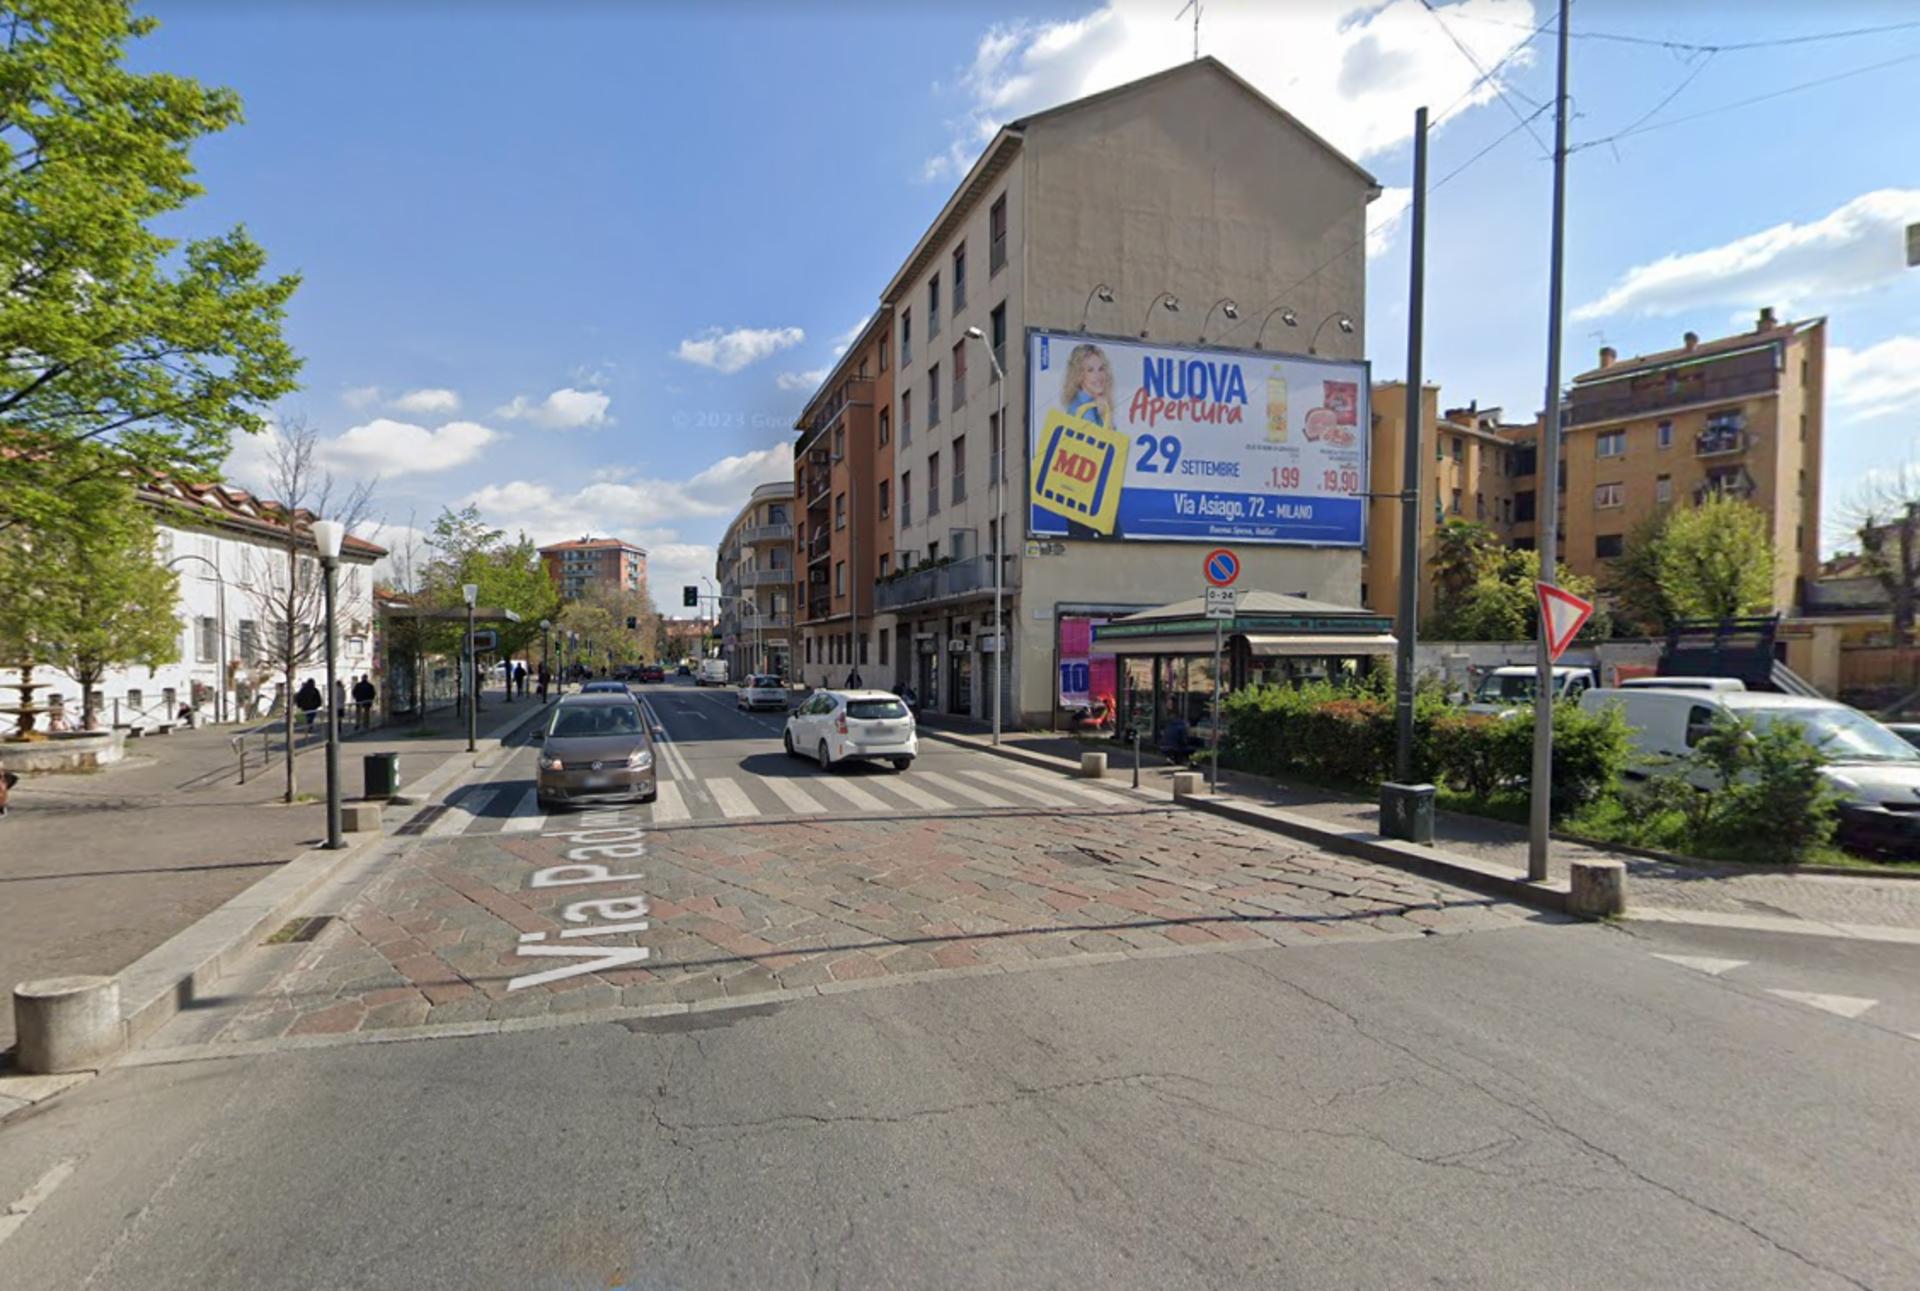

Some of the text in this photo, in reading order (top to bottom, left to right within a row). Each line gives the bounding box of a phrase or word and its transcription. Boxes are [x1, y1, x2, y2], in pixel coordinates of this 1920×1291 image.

[1143, 356, 1248, 405] NUOVA
[1128, 387, 1243, 428] Apertura
[1052, 448, 1098, 483] MD
[1136, 433, 1240, 477] 29 SETTEMBRE
[1173, 493, 1196, 515] Via
[1248, 497, 1265, 517] 72
[1276, 503, 1313, 519] MILANO
[1060, 663, 1089, 693] 10
